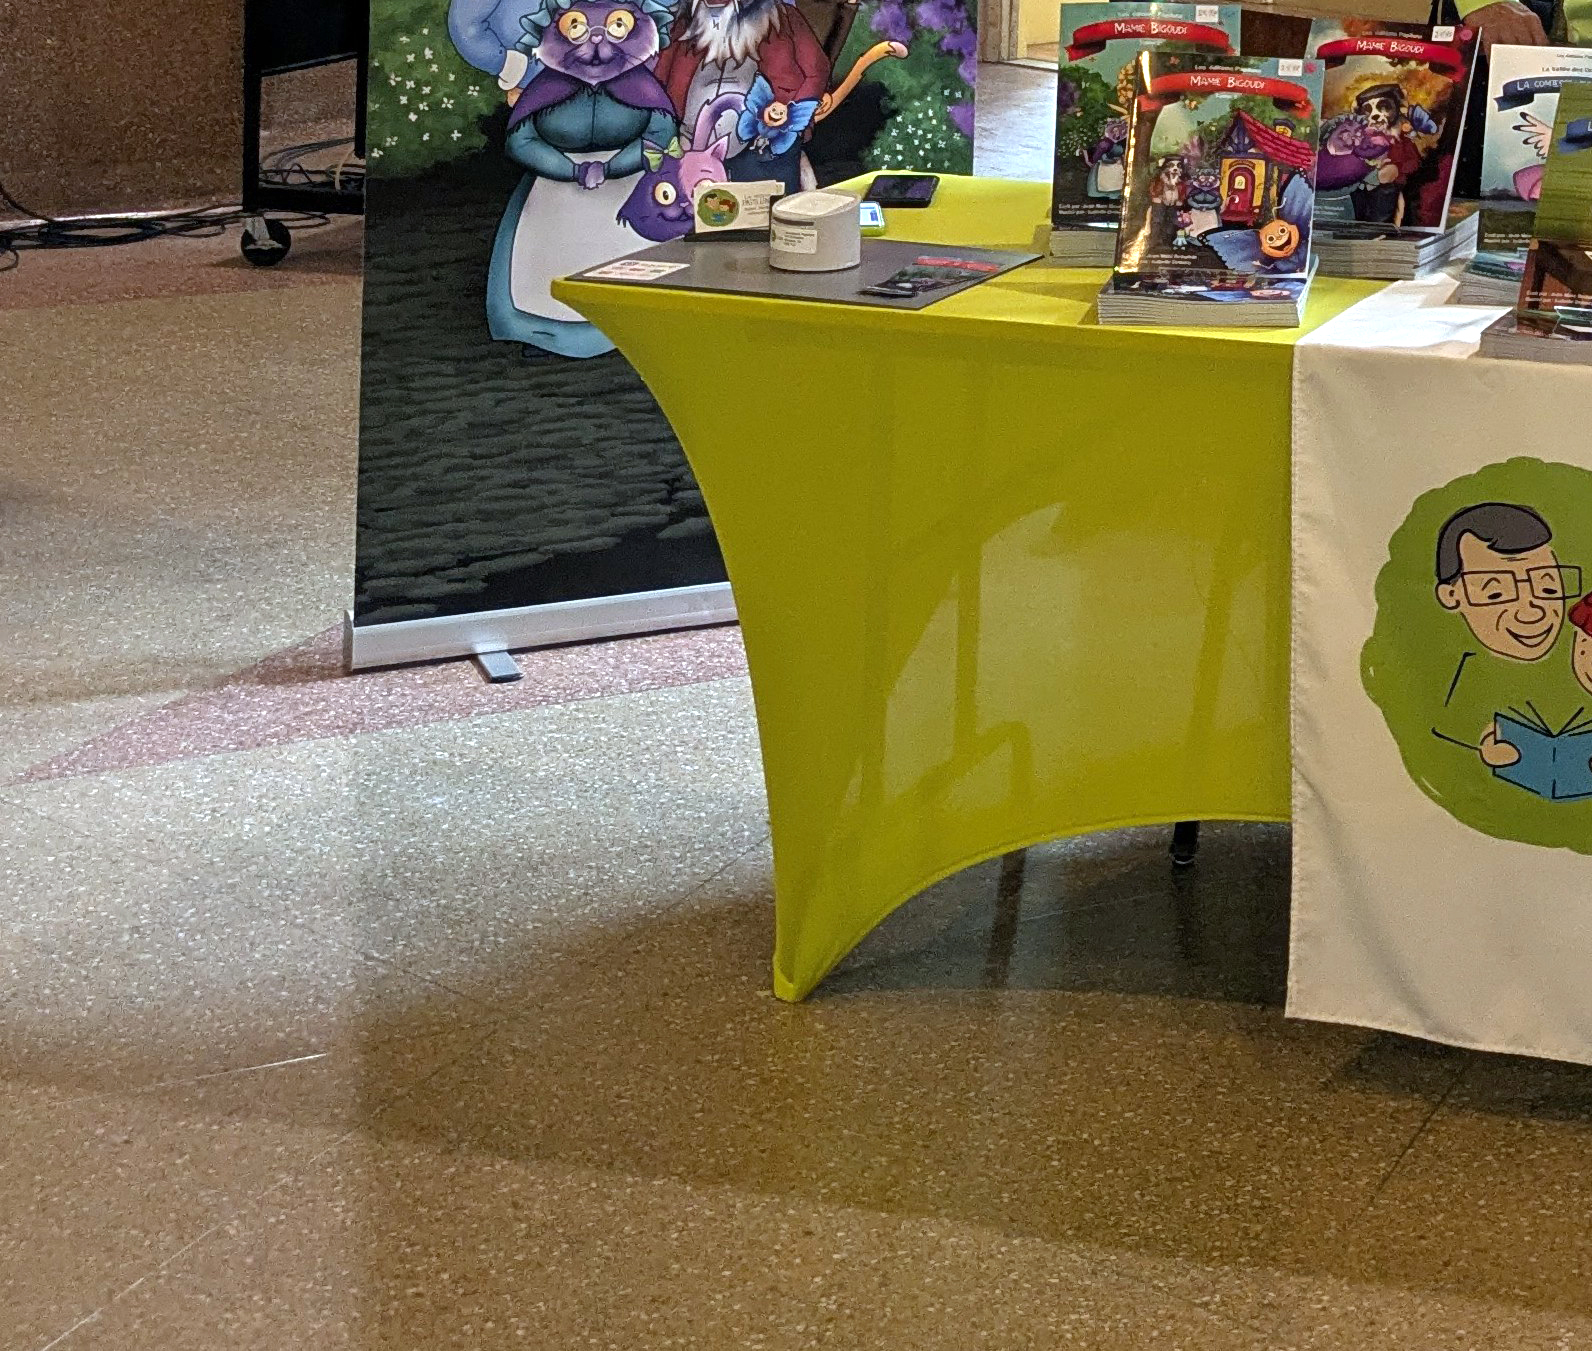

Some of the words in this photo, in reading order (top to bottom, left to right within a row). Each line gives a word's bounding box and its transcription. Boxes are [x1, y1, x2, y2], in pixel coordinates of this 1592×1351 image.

[1114, 22, 1145, 34] MAMIE
[1150, 22, 1188, 35] BIGOUDI
[1356, 40, 1386, 51] MAMIE
[1390, 41, 1425, 54] BIGOUDI
[1190, 75, 1222, 87] MAMIE
[1227, 76, 1266, 89] BIGOUDI
